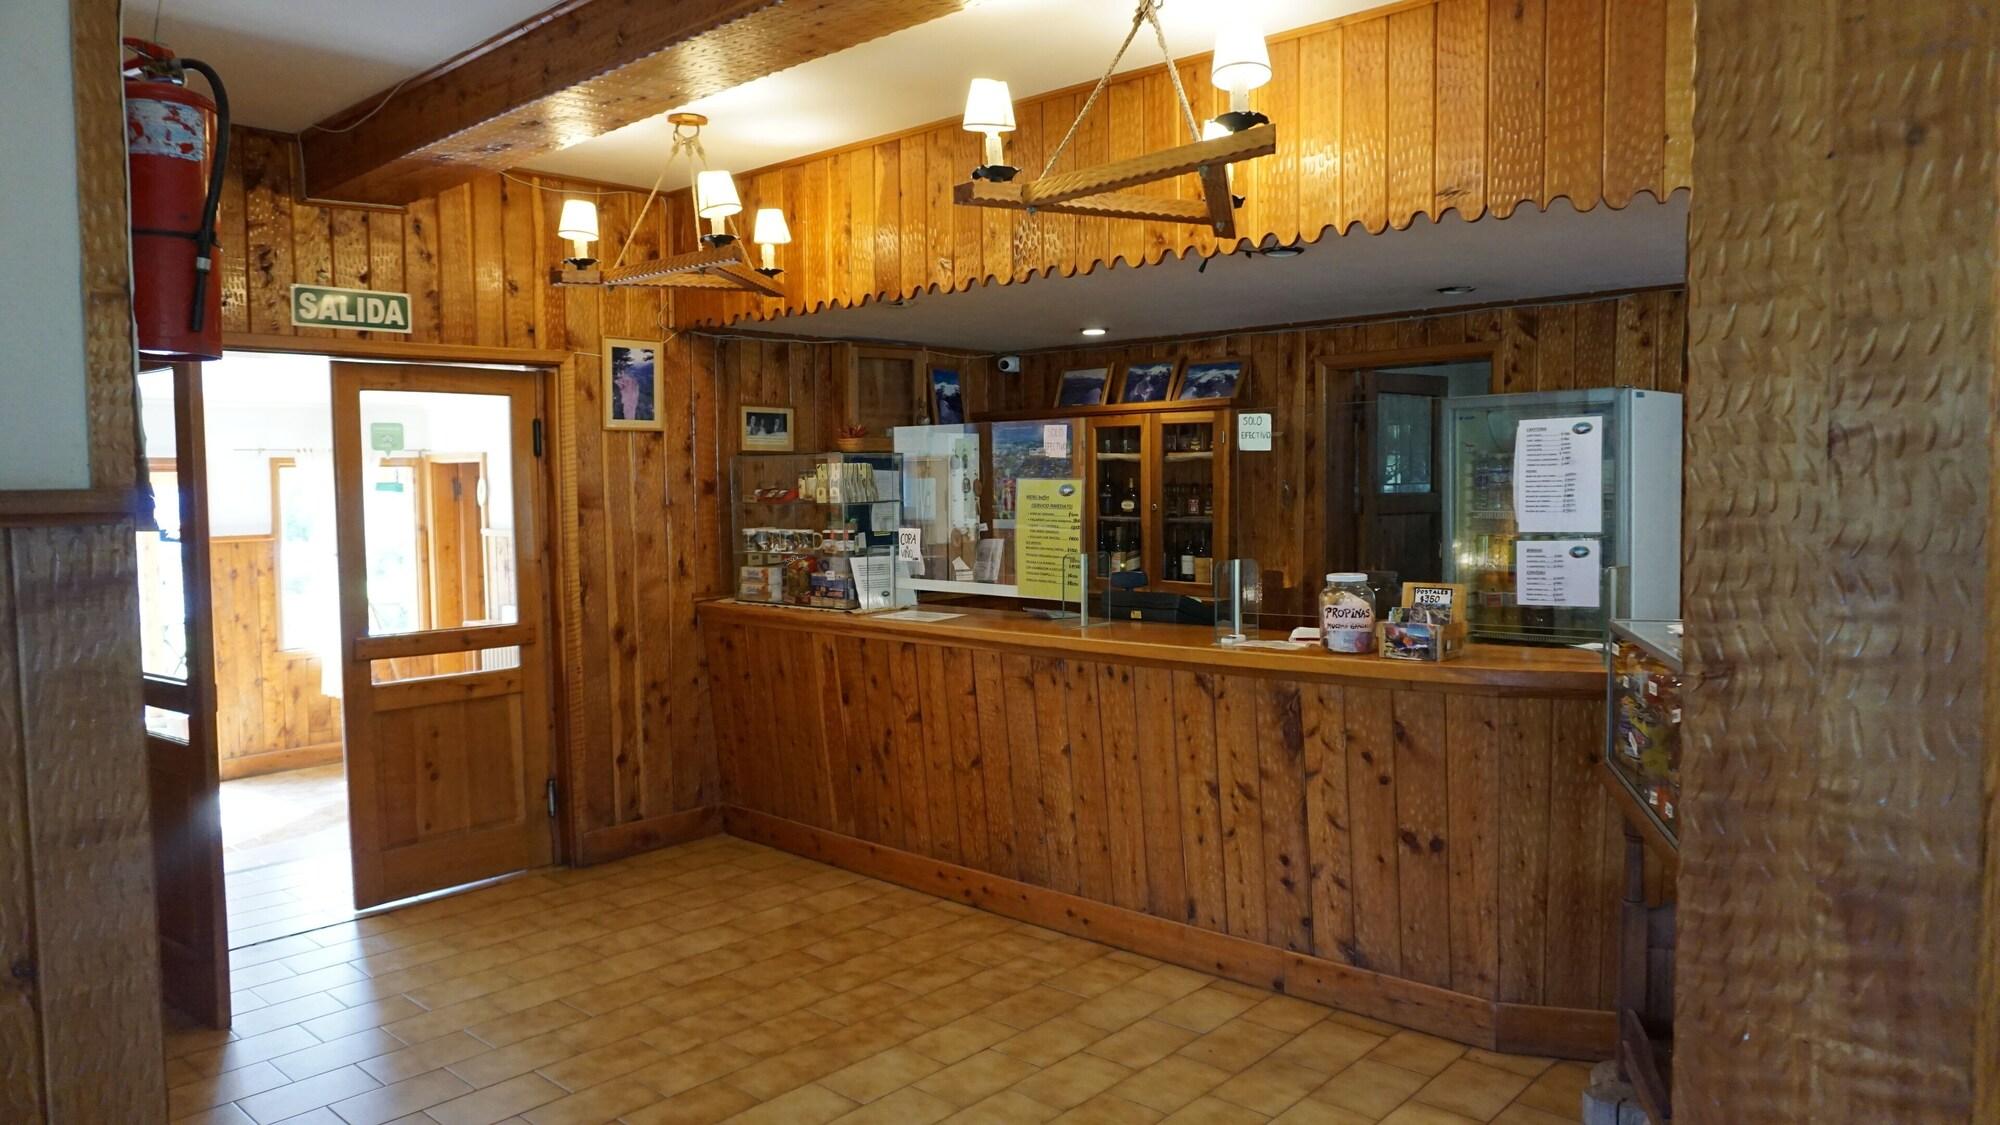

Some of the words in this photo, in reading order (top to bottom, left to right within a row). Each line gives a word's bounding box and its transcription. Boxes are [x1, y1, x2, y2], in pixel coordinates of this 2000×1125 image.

[299, 292, 405, 326] SALIDA
[1242, 416, 1263, 426] SOLO
[1241, 431, 1271, 440] EFECTIVO
[901, 533, 917, 545] COPA
[1416, 588, 1448, 596] POSTALES
[1420, 595, 1441, 603] $350
